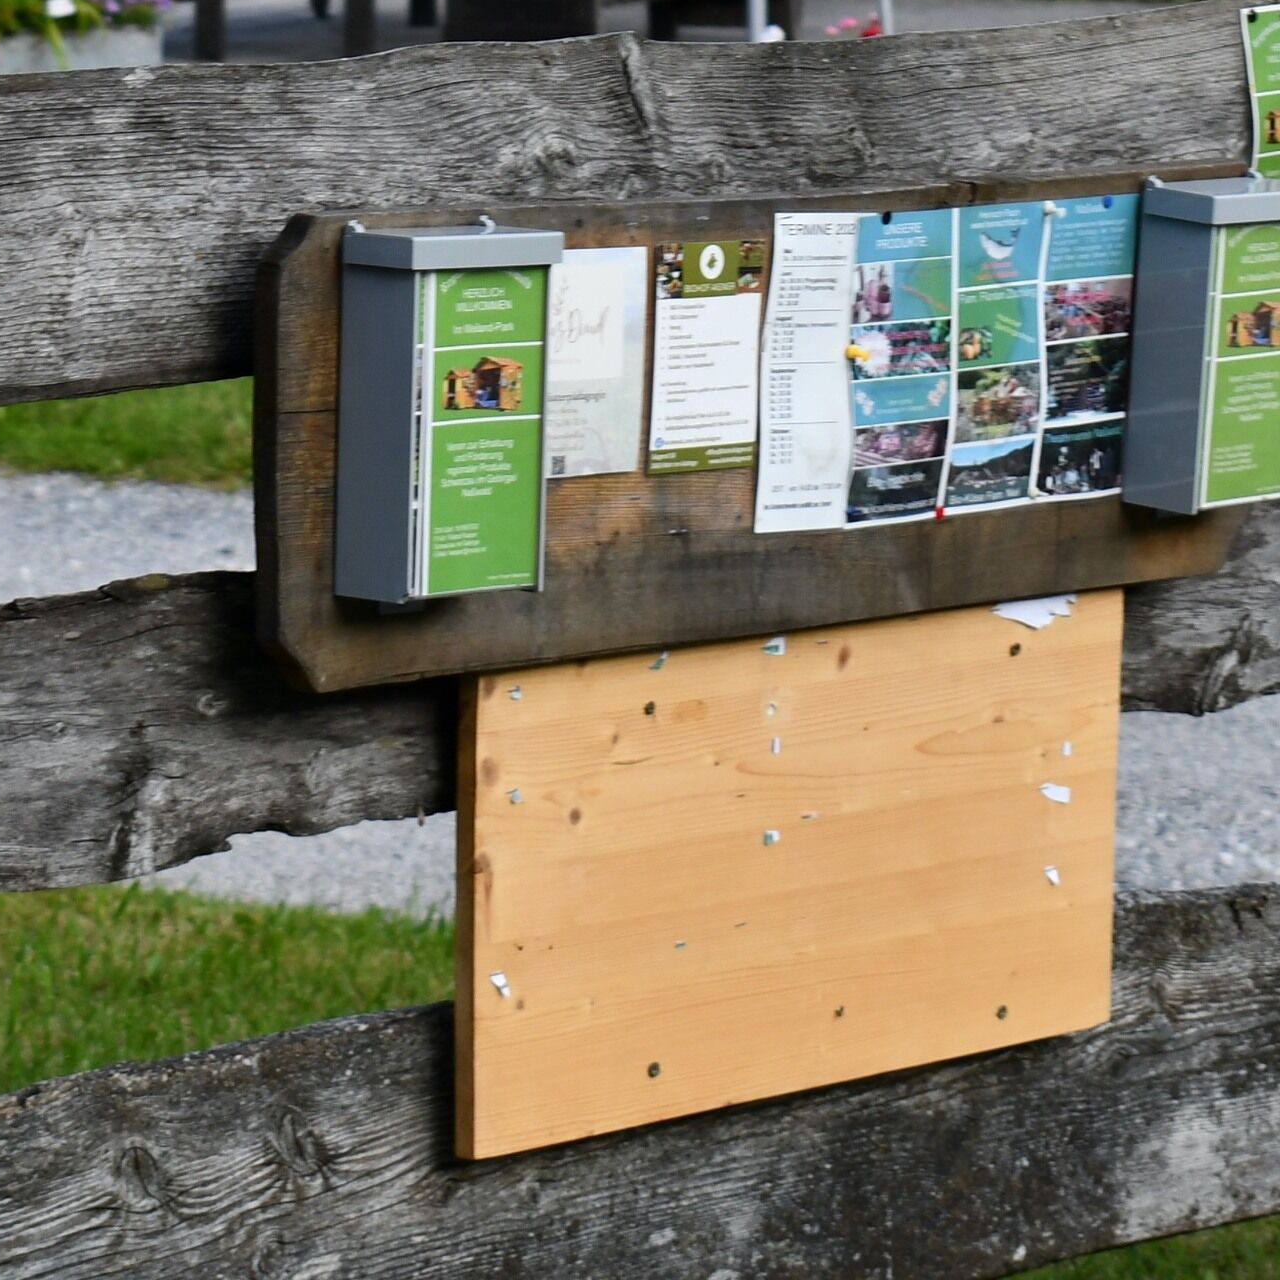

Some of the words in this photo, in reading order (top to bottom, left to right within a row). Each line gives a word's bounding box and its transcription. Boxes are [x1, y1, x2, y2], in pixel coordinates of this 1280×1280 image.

[780, 223, 833, 236] TERMINE
[882, 222, 923, 235] UNSERE
[875, 236, 929, 250] PRODUKTE
